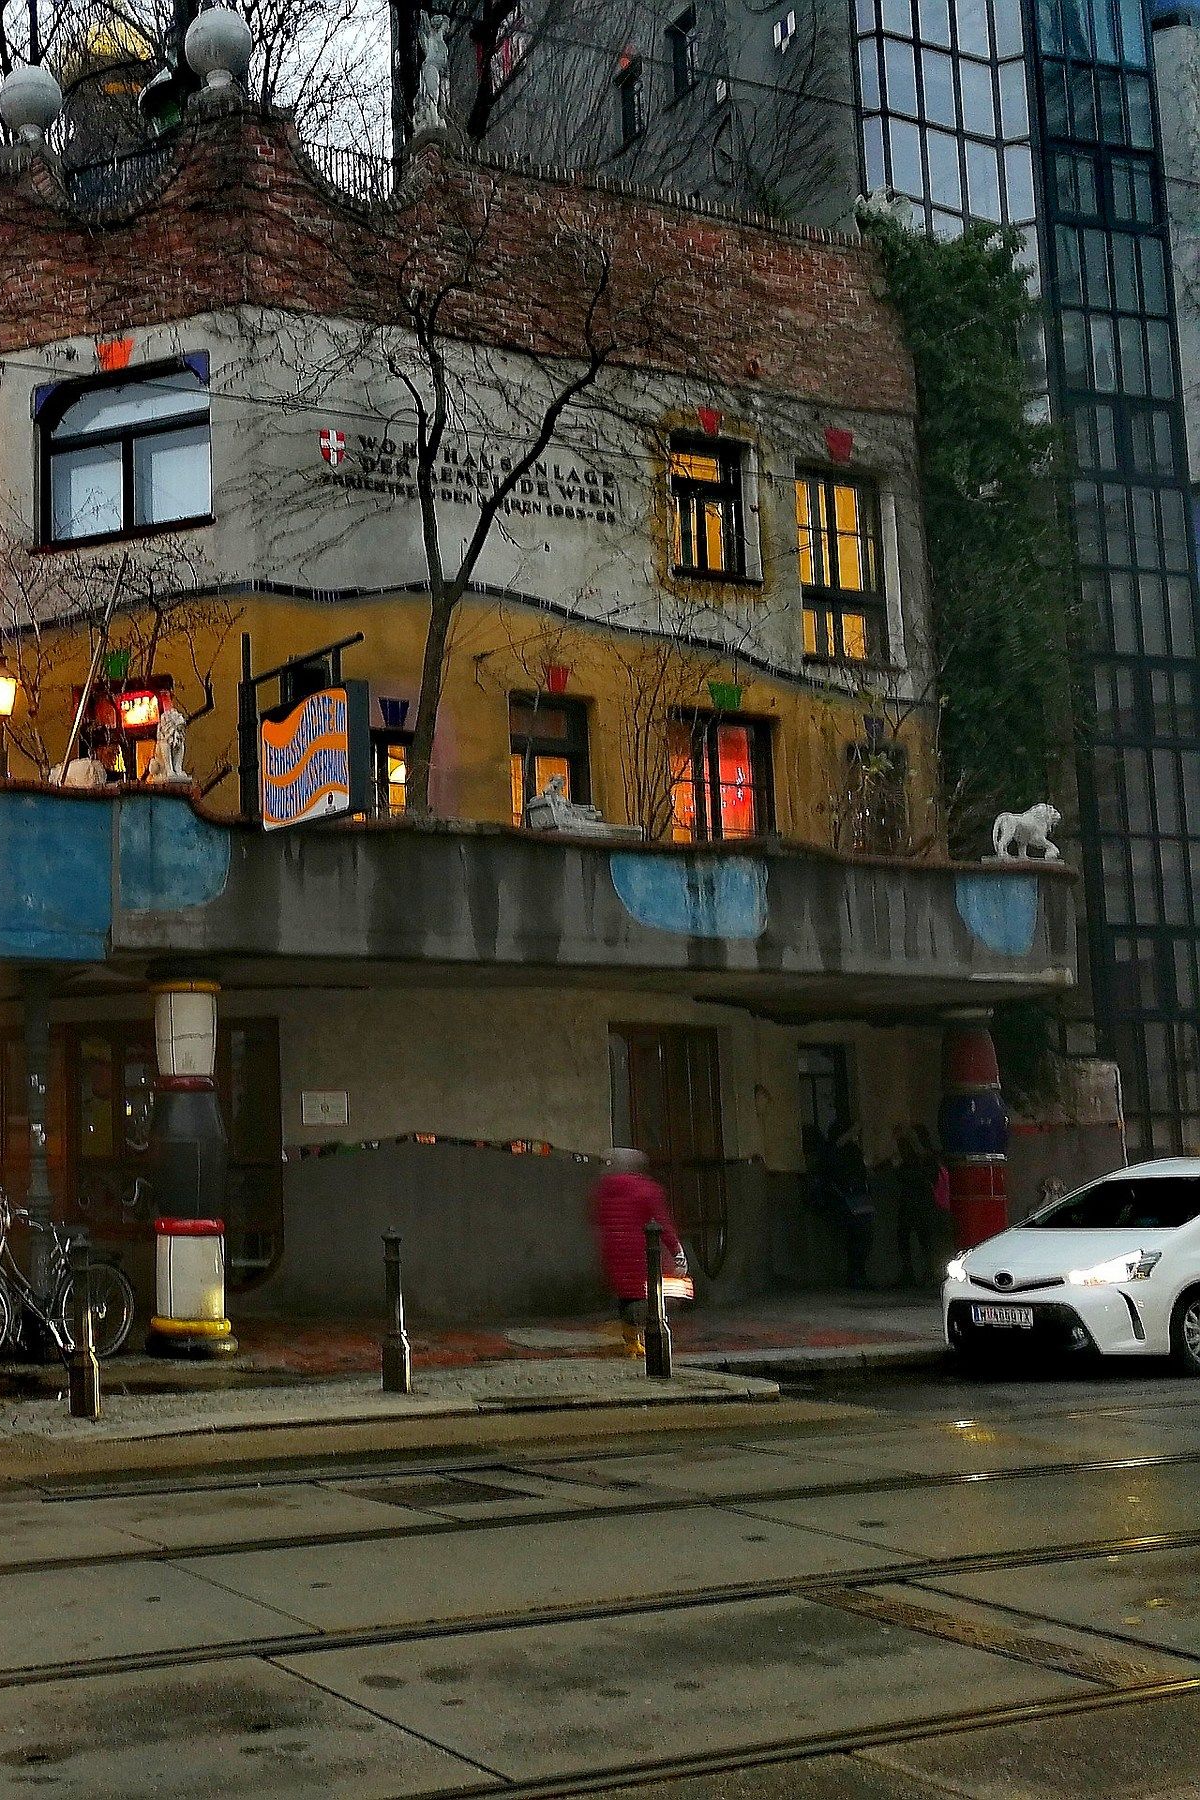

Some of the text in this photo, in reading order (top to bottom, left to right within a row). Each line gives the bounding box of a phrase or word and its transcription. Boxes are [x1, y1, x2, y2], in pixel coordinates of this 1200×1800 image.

[358, 434, 615, 488] WOHHAUSNLAGE
[426, 464, 549, 498] EMEIDE
[558, 483, 615, 507] WIEN
